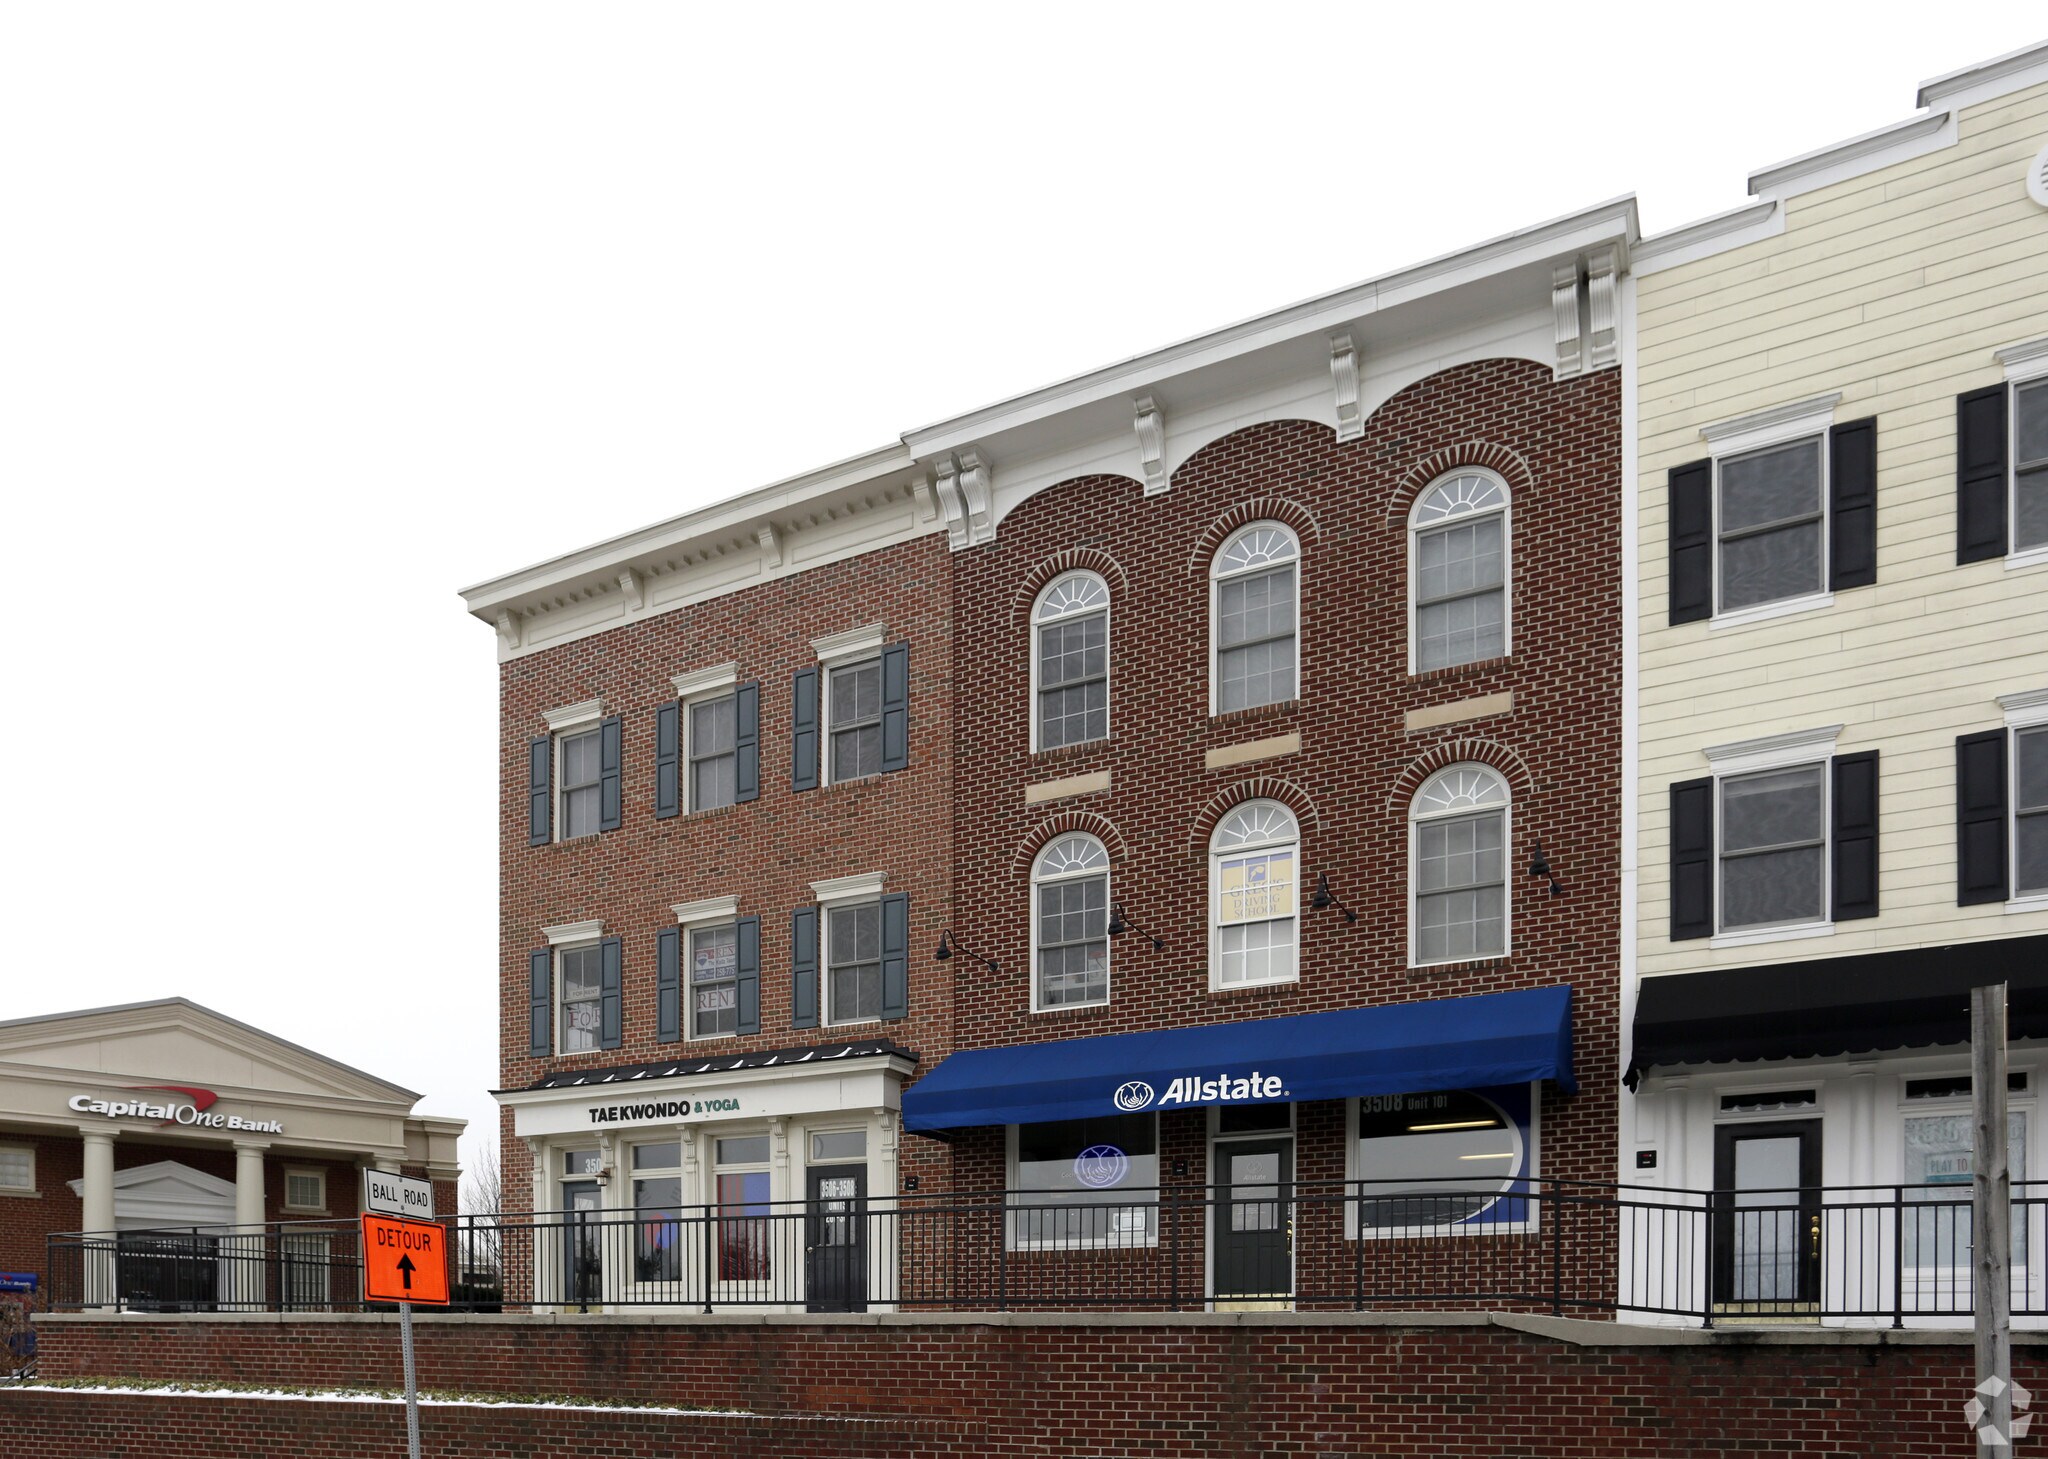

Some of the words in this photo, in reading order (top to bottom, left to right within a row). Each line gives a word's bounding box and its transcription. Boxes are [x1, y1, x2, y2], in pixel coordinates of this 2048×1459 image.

[1233, 893, 1281, 909] DRIVING
[1234, 904, 1280, 919] SCHOOL
[1158, 1071, 1283, 1106] Allstate
[694, 1101, 703, 1114] &
[704, 1098, 740, 1112] YOGA
[1362, 1094, 1403, 1114] 3508
[1408, 1097, 1428, 1110] Unit
[1433, 1095, 1448, 1108] 101
[226, 1115, 283, 1134] Bank
[1930, 1159, 1953, 1174] PLAY
[1957, 1158, 1968, 1173] TO
[372, 1183, 398, 1202] BALL
[404, 1189, 428, 1207] ROAD
[821, 1179, 855, 1198] 3506-3508
[377, 1227, 431, 1252] DETOUR
